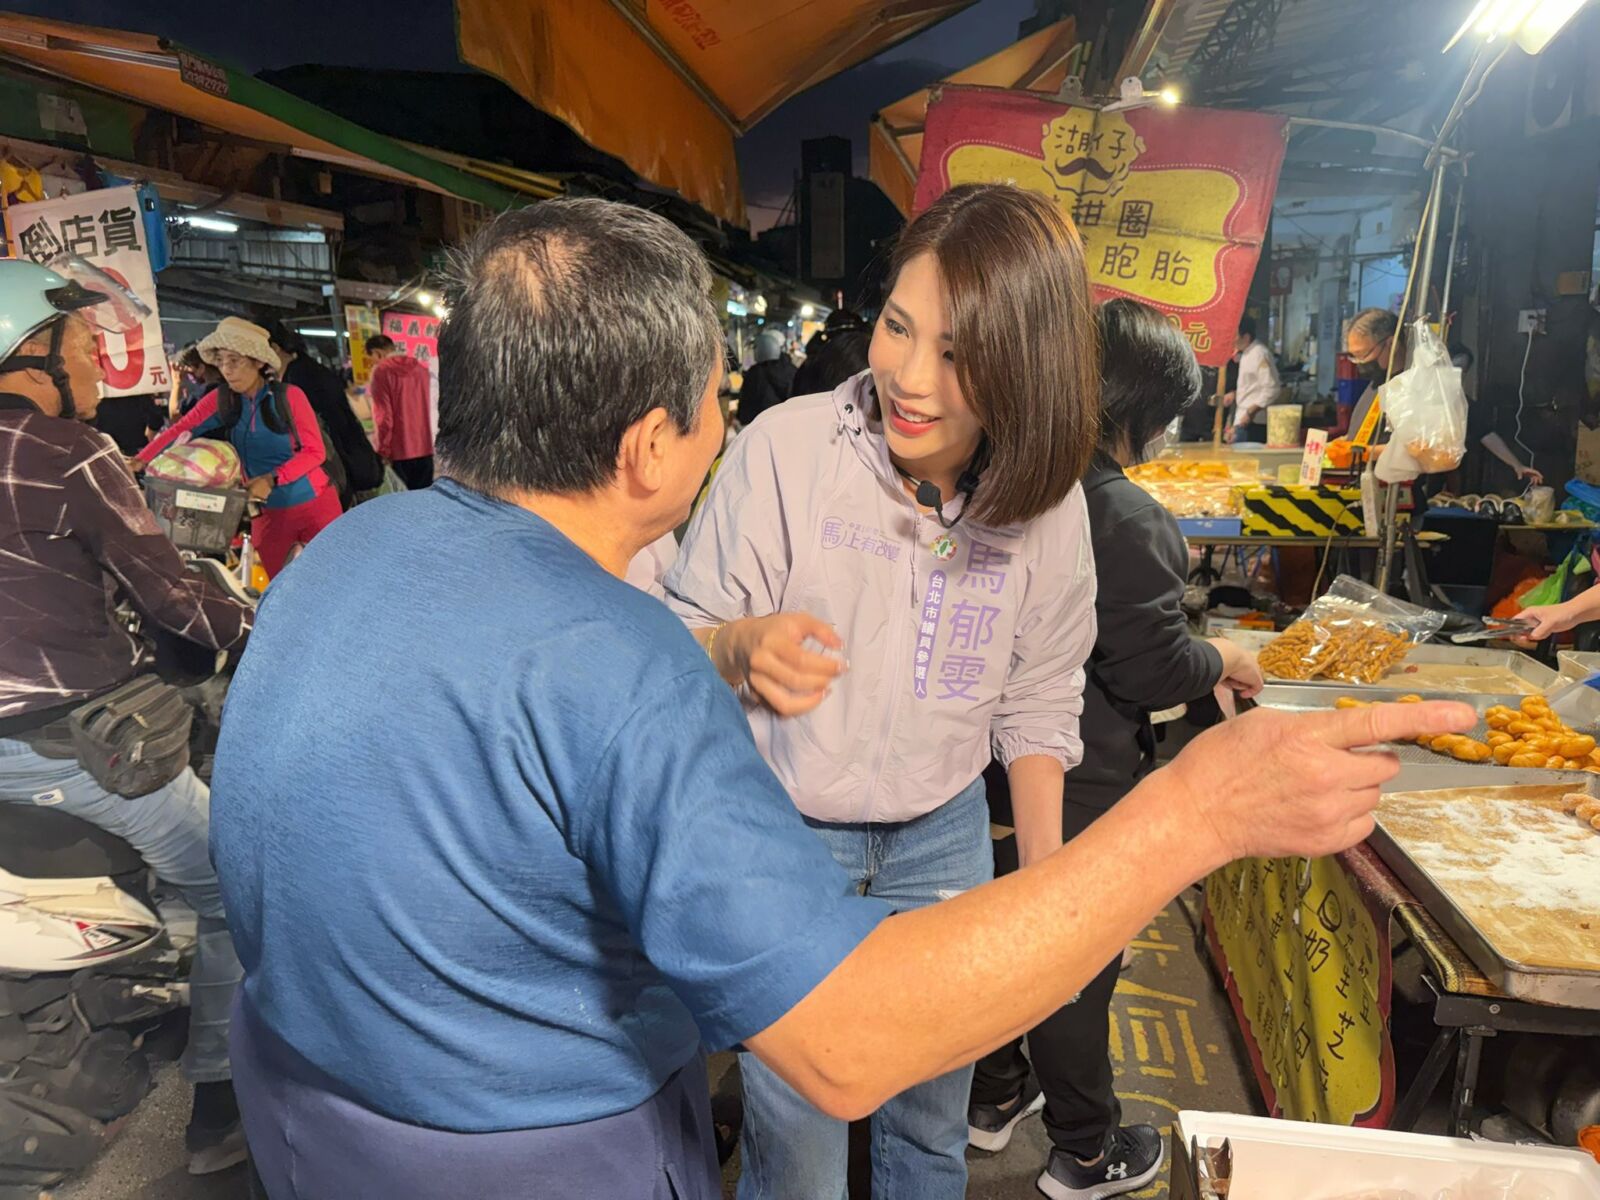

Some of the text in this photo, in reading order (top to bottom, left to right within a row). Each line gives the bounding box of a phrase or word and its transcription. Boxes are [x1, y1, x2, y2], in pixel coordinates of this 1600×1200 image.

[1053, 194, 1154, 239] 甜圈
[1081, 235, 1192, 286] 胞胎
[150, 366, 167, 386] 元
[935, 540, 1011, 702] 馬郁雯
